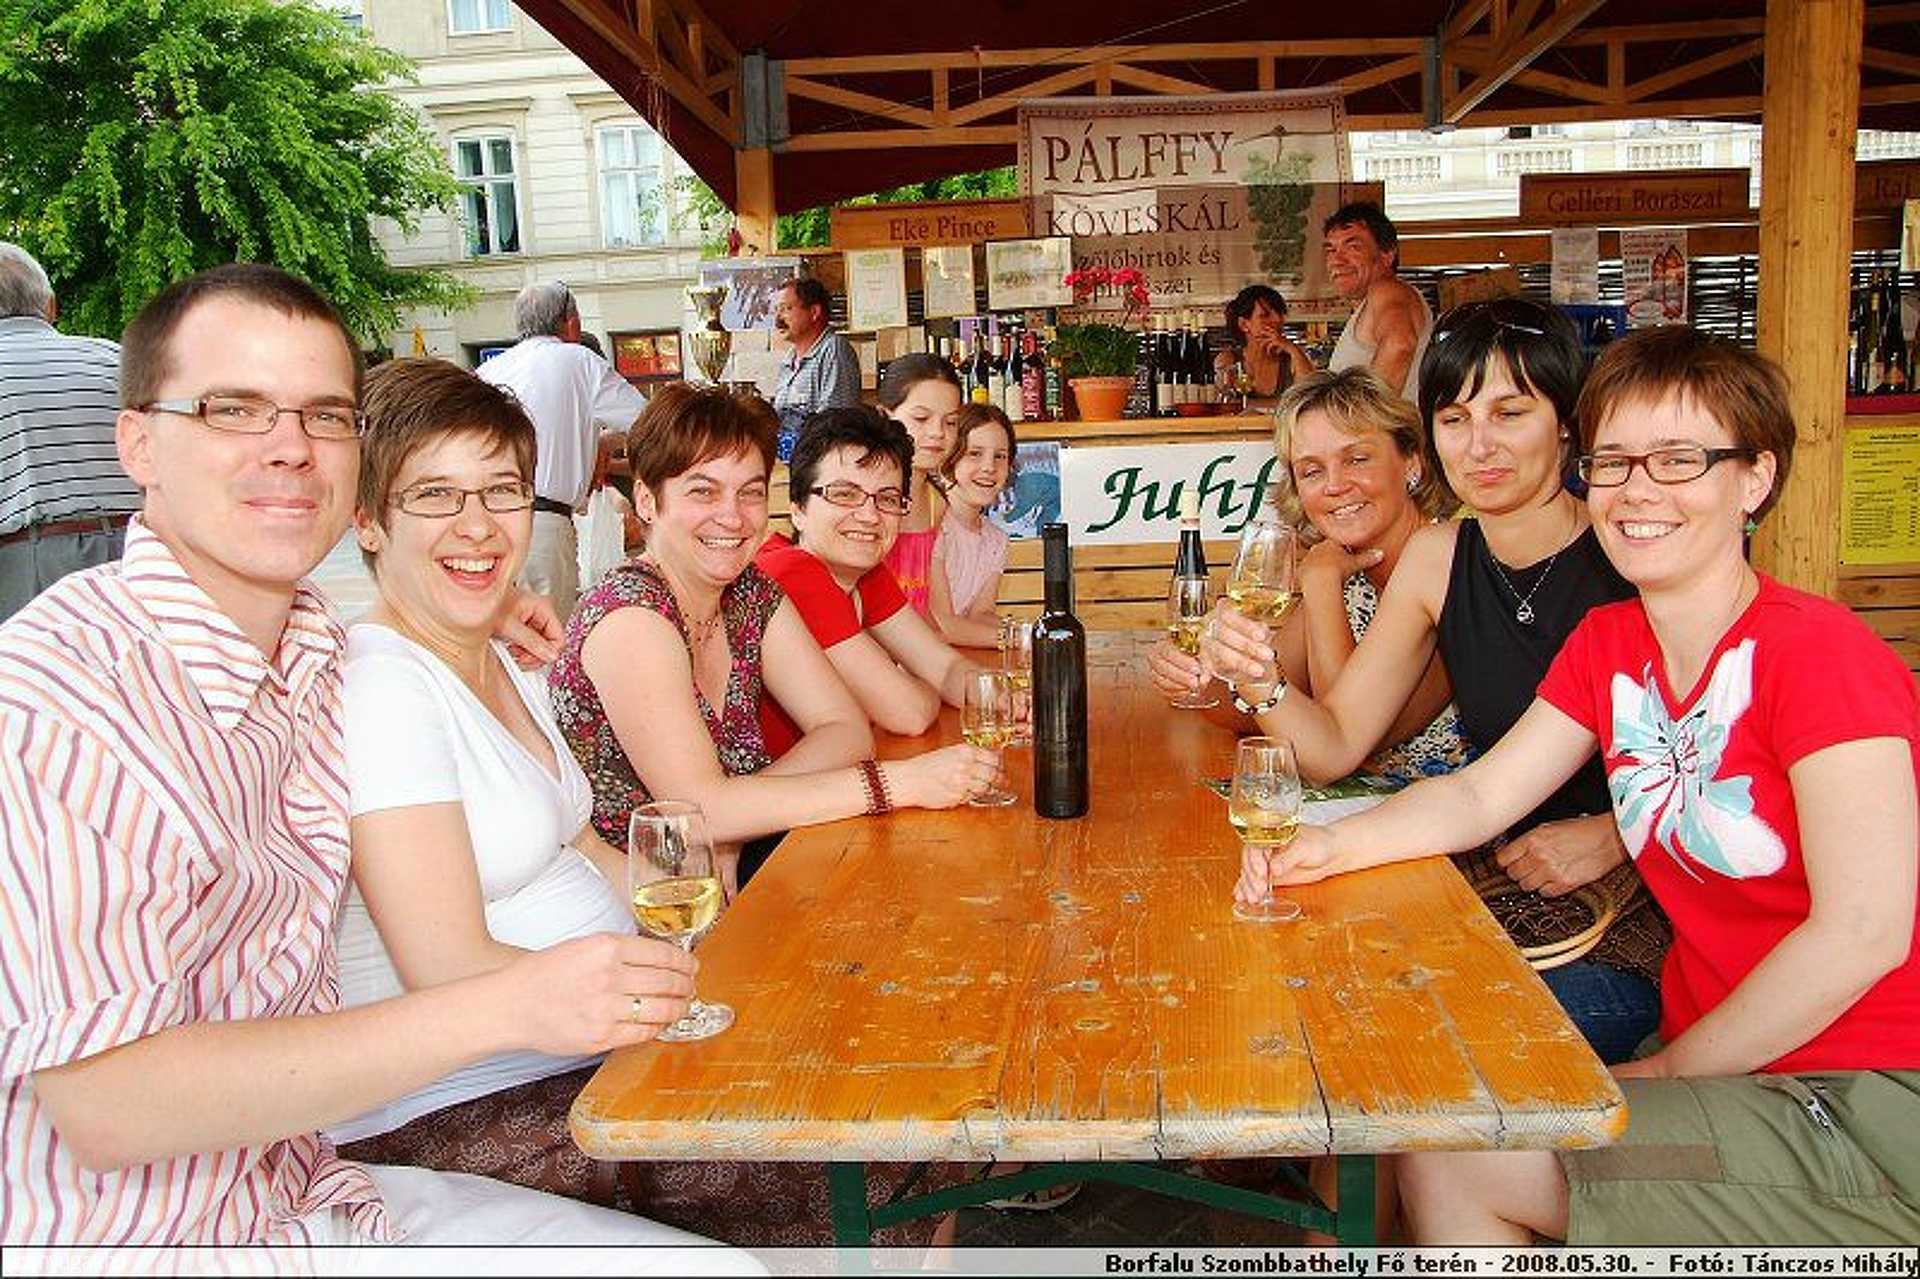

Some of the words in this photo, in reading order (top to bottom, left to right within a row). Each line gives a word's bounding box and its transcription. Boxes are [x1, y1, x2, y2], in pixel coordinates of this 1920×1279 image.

[1041, 122, 1234, 183] PÁLFFY
[937, 215, 996, 239] Pince
[1045, 194, 1240, 239] KÖVESKÁL
[1199, 242, 1220, 265] és
